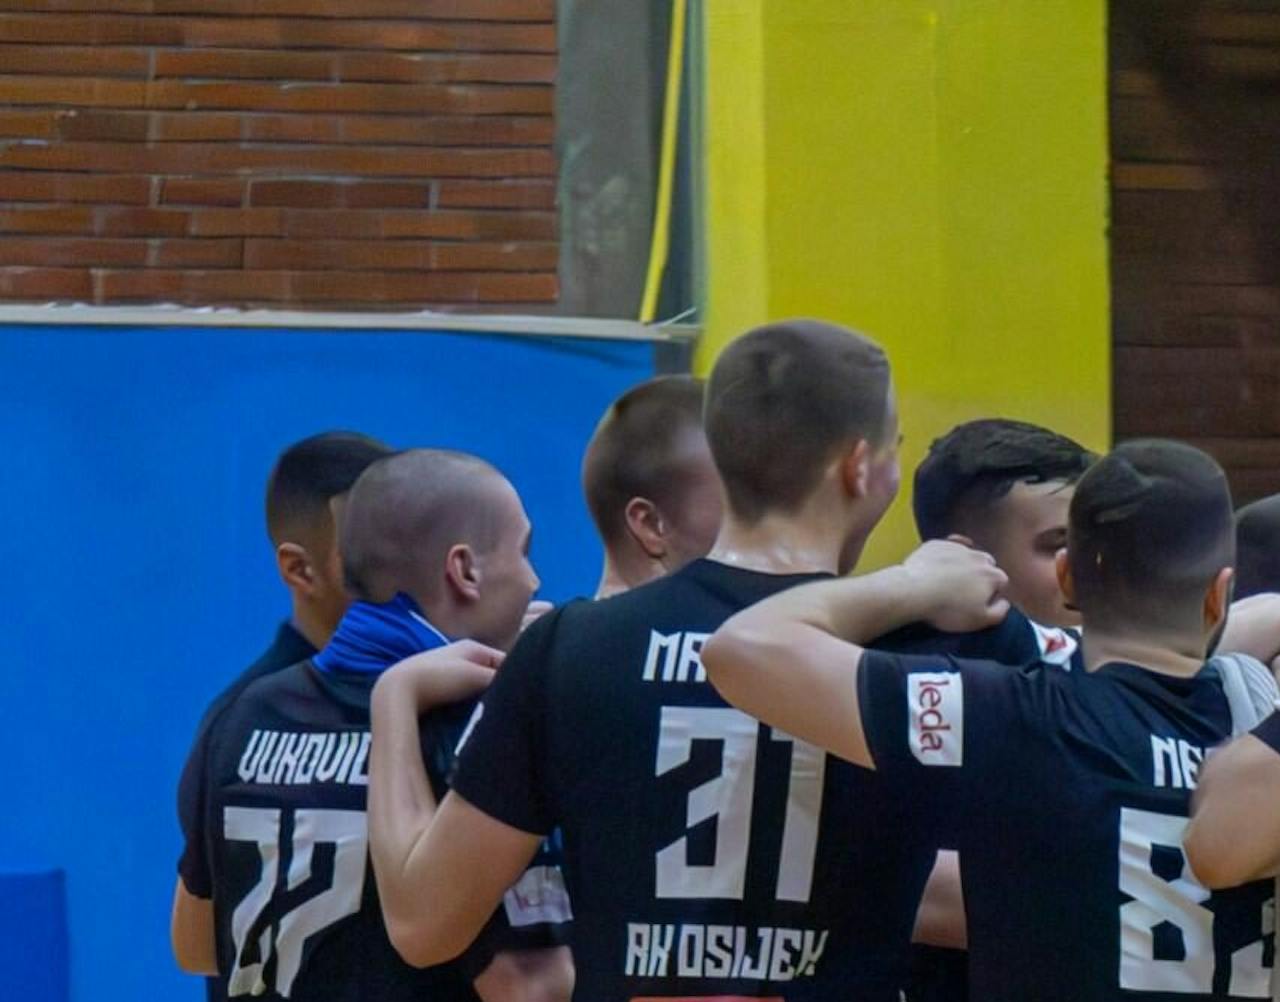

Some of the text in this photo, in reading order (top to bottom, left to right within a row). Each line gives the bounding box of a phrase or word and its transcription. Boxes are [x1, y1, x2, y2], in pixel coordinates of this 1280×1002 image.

[918, 679, 952, 754] leda
[655, 706, 826, 903] 31
[625, 923, 829, 980] RK OSIJEK
